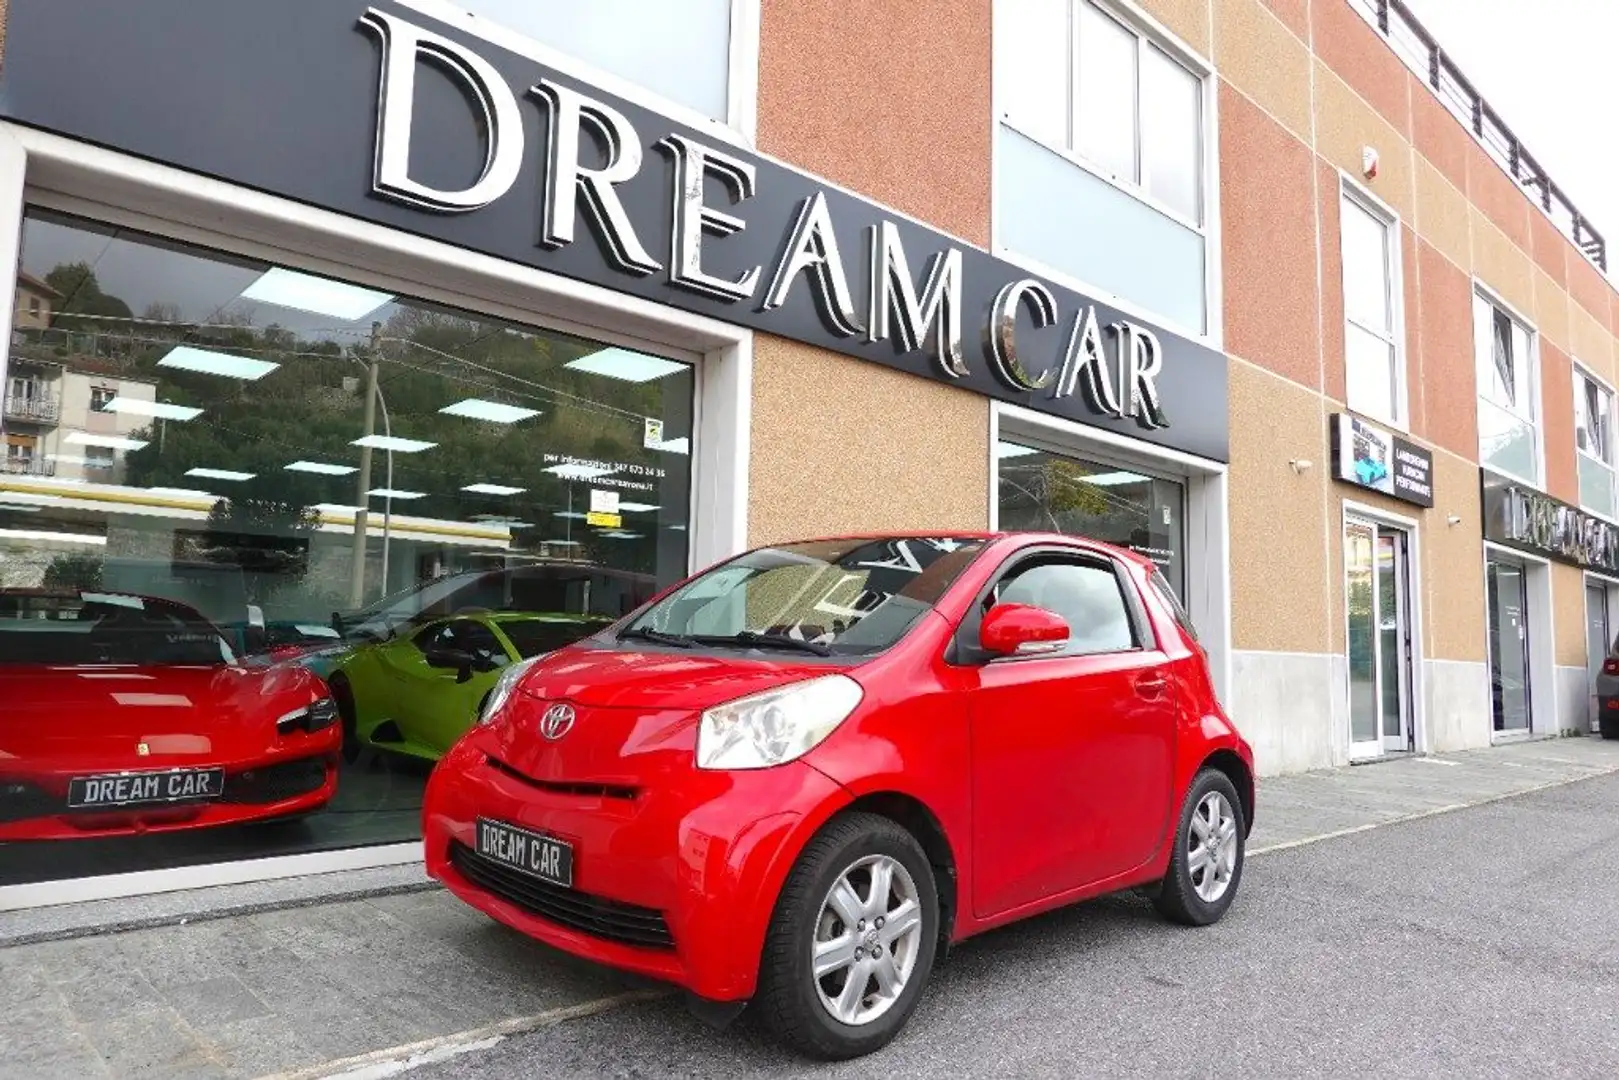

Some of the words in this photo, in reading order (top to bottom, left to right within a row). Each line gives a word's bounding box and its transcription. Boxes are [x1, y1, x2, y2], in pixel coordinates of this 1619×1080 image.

[358, 7, 970, 378] DREAM
[988, 279, 1170, 430] CAR
[84, 776, 160, 803] DREAM
[168, 773, 210, 796] CAR
[482, 823, 526, 866] DREAM
[531, 840, 560, 877] CAR
